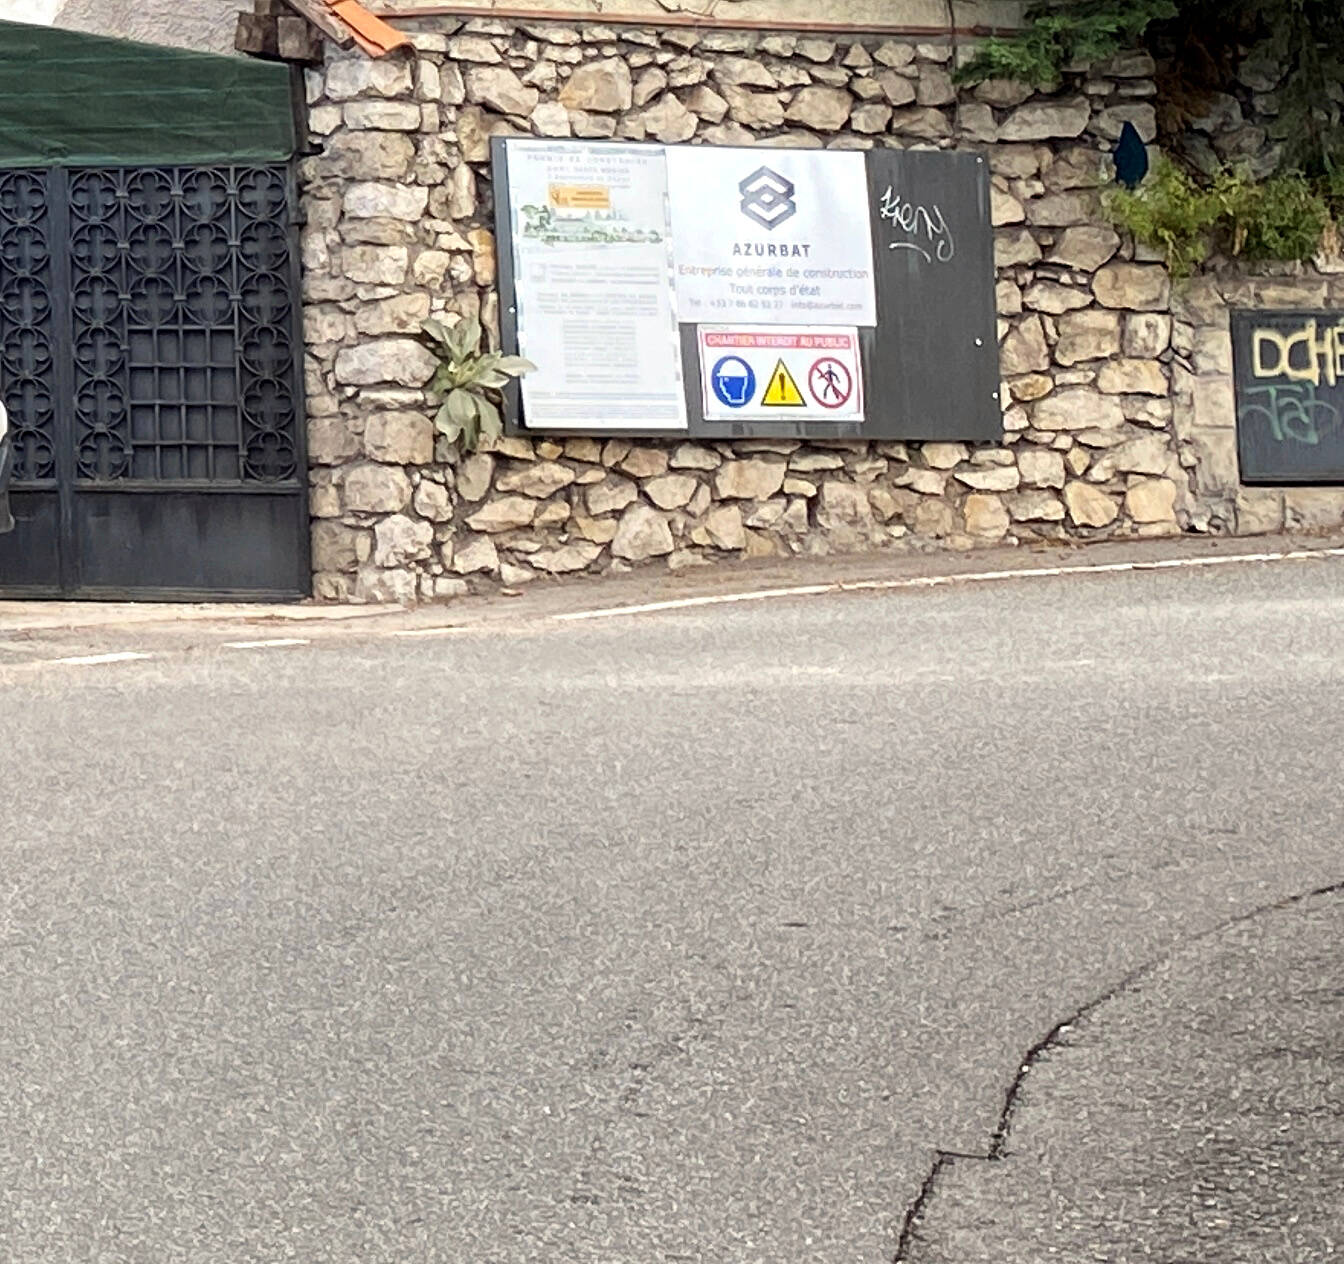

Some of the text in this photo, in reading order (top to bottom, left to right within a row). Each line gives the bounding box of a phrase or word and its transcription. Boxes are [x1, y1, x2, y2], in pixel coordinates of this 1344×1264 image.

[732, 242, 811, 257] AZURBAT
[678, 264, 869, 280] Entreprise générale de construction
[729, 283, 821, 297] Tout corps d'état
